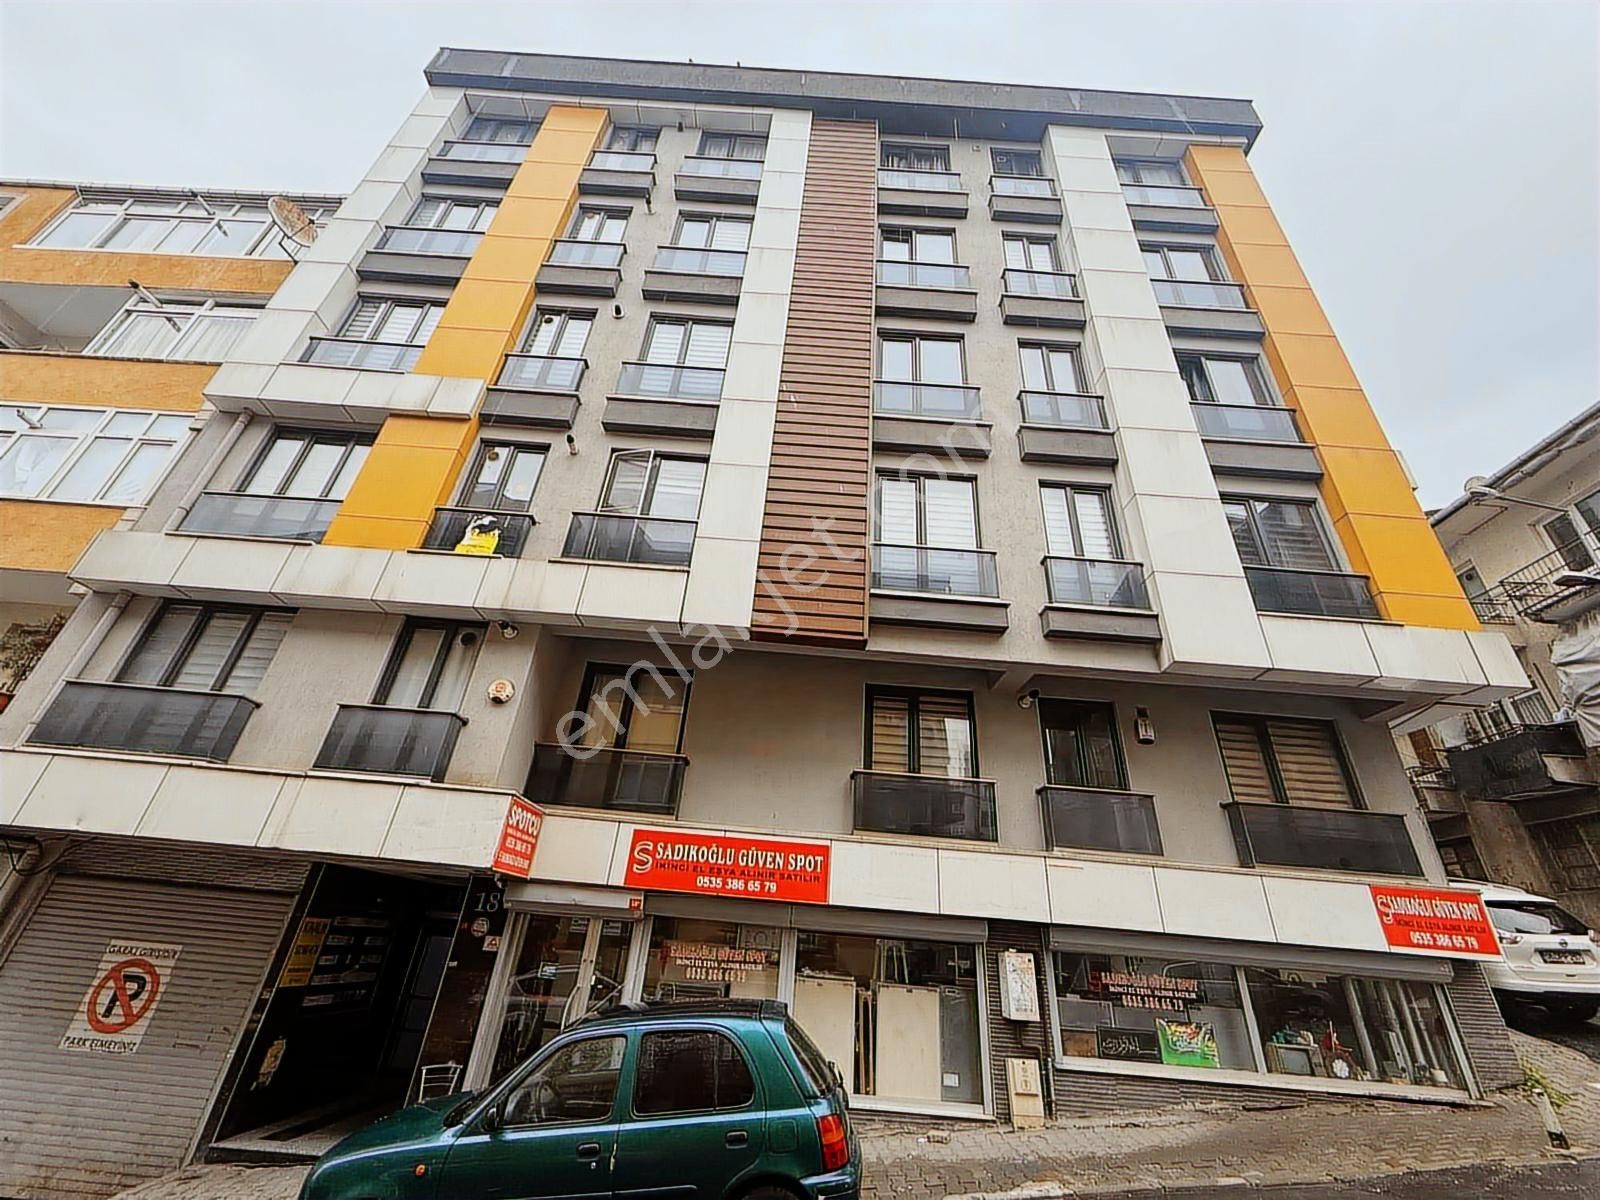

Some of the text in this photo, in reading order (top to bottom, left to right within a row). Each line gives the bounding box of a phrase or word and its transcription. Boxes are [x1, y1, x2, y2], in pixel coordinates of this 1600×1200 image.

[508, 804, 541, 836] SPOTCU
[655, 842, 824, 873] SADIKOĞLU GÜVEN SPOT
[692, 866, 705, 875] EL
[696, 875, 777, 893] 0535 386 65 79
[472, 892, 501, 913] 18
